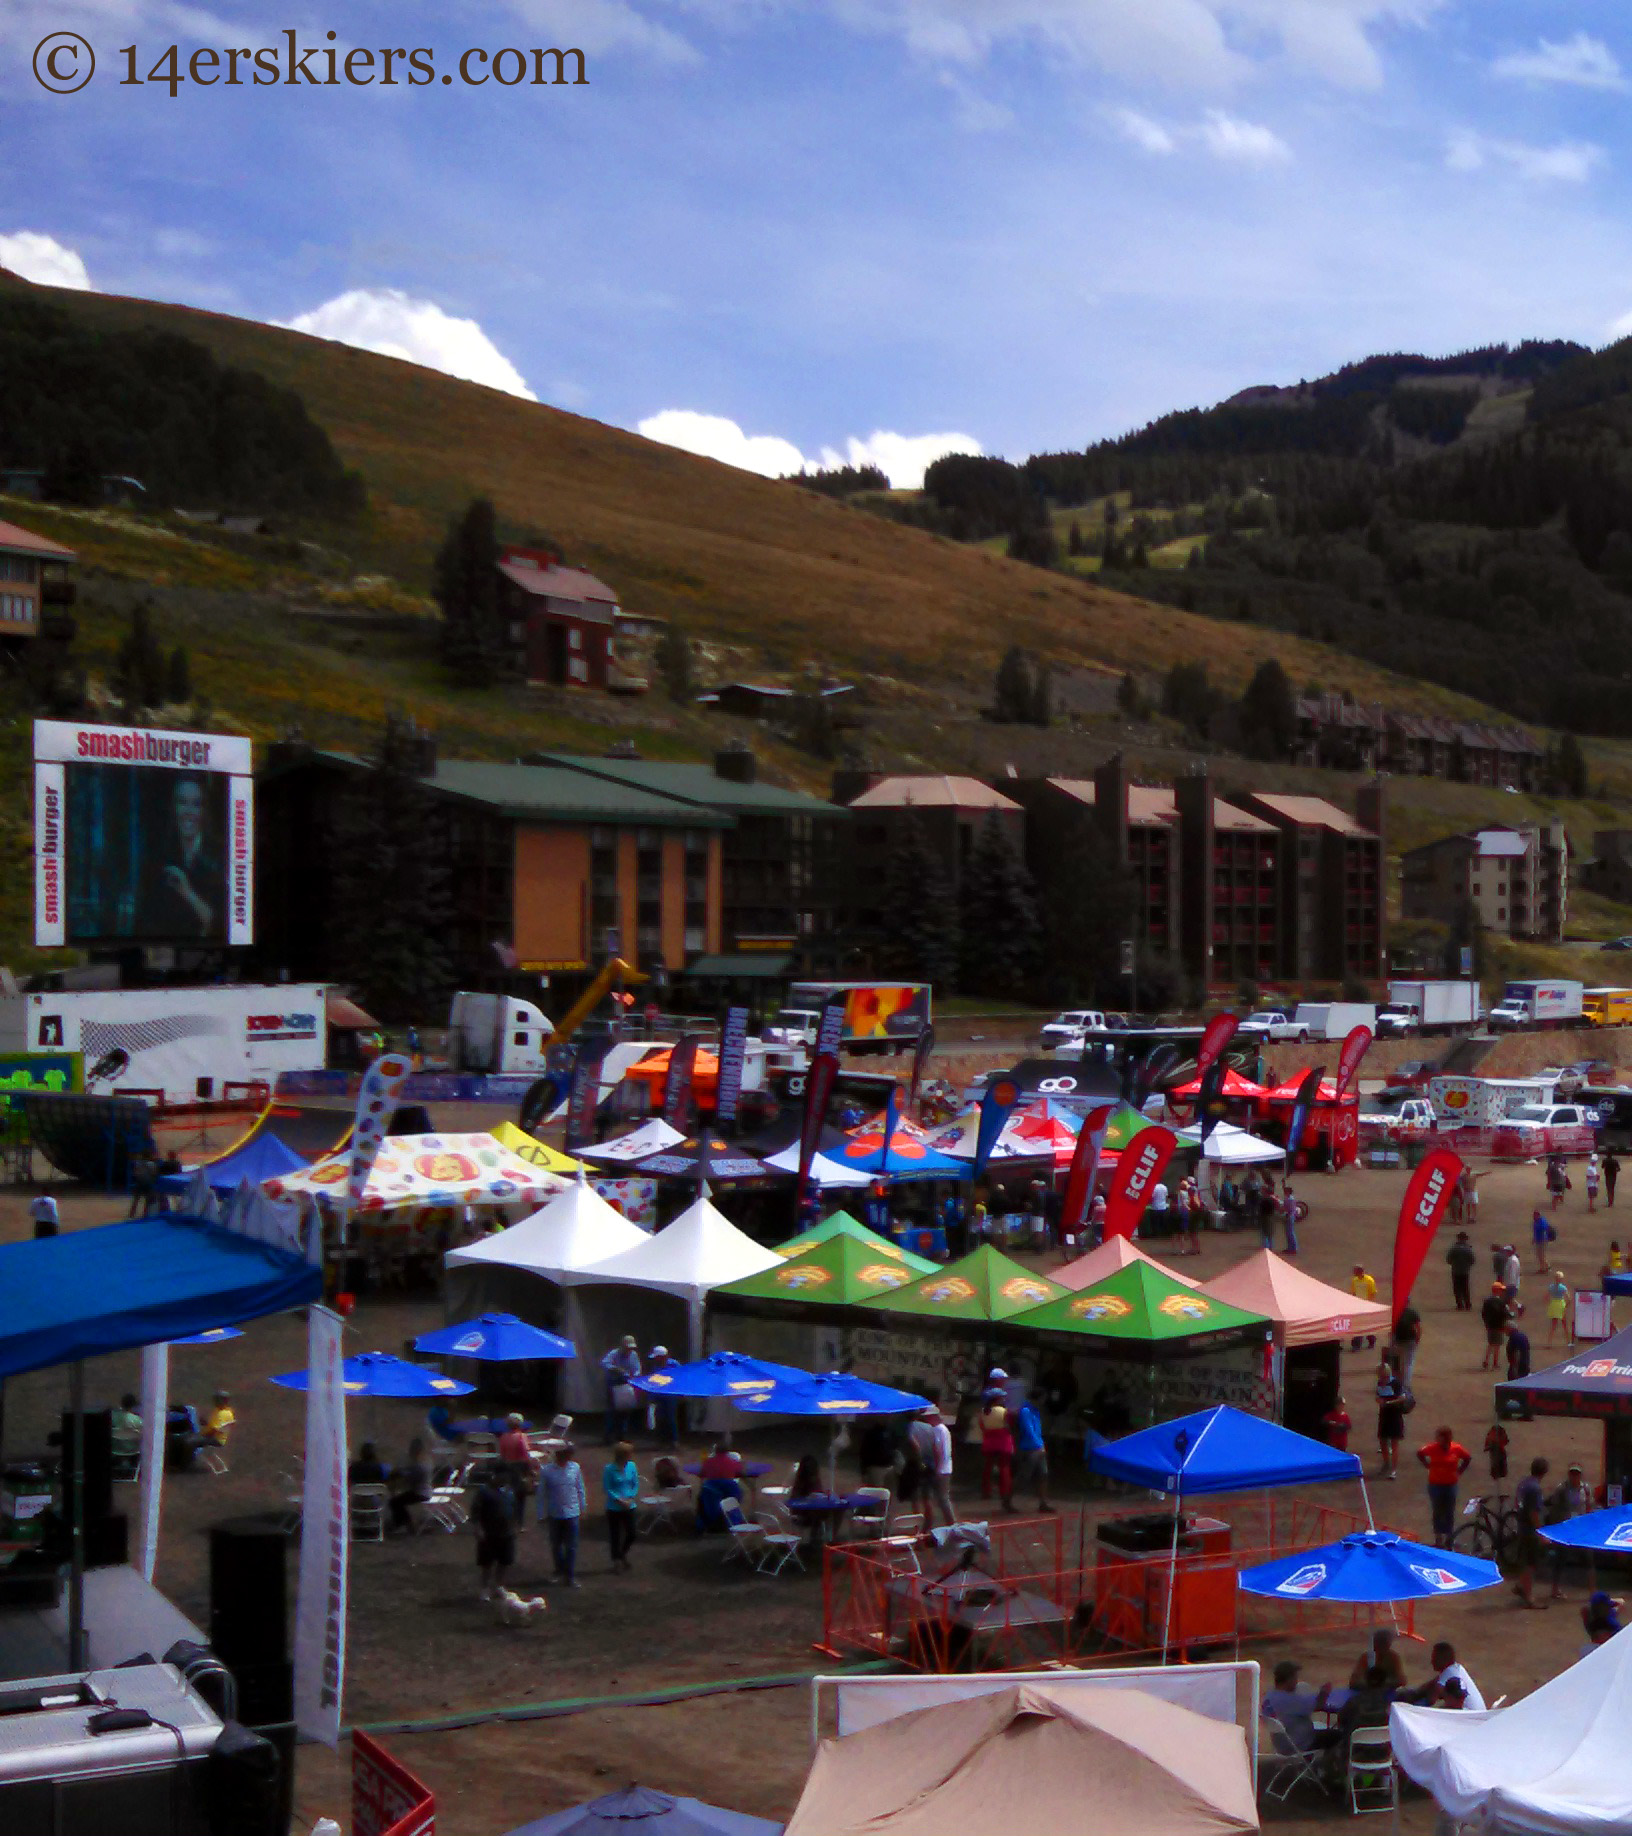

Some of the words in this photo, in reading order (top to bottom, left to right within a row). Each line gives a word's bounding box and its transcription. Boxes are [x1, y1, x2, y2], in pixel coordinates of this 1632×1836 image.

[77, 731, 211, 766] smashburger
[1130, 1144, 1159, 1190] CLIF
[1420, 1168, 1446, 1216] CLIF
